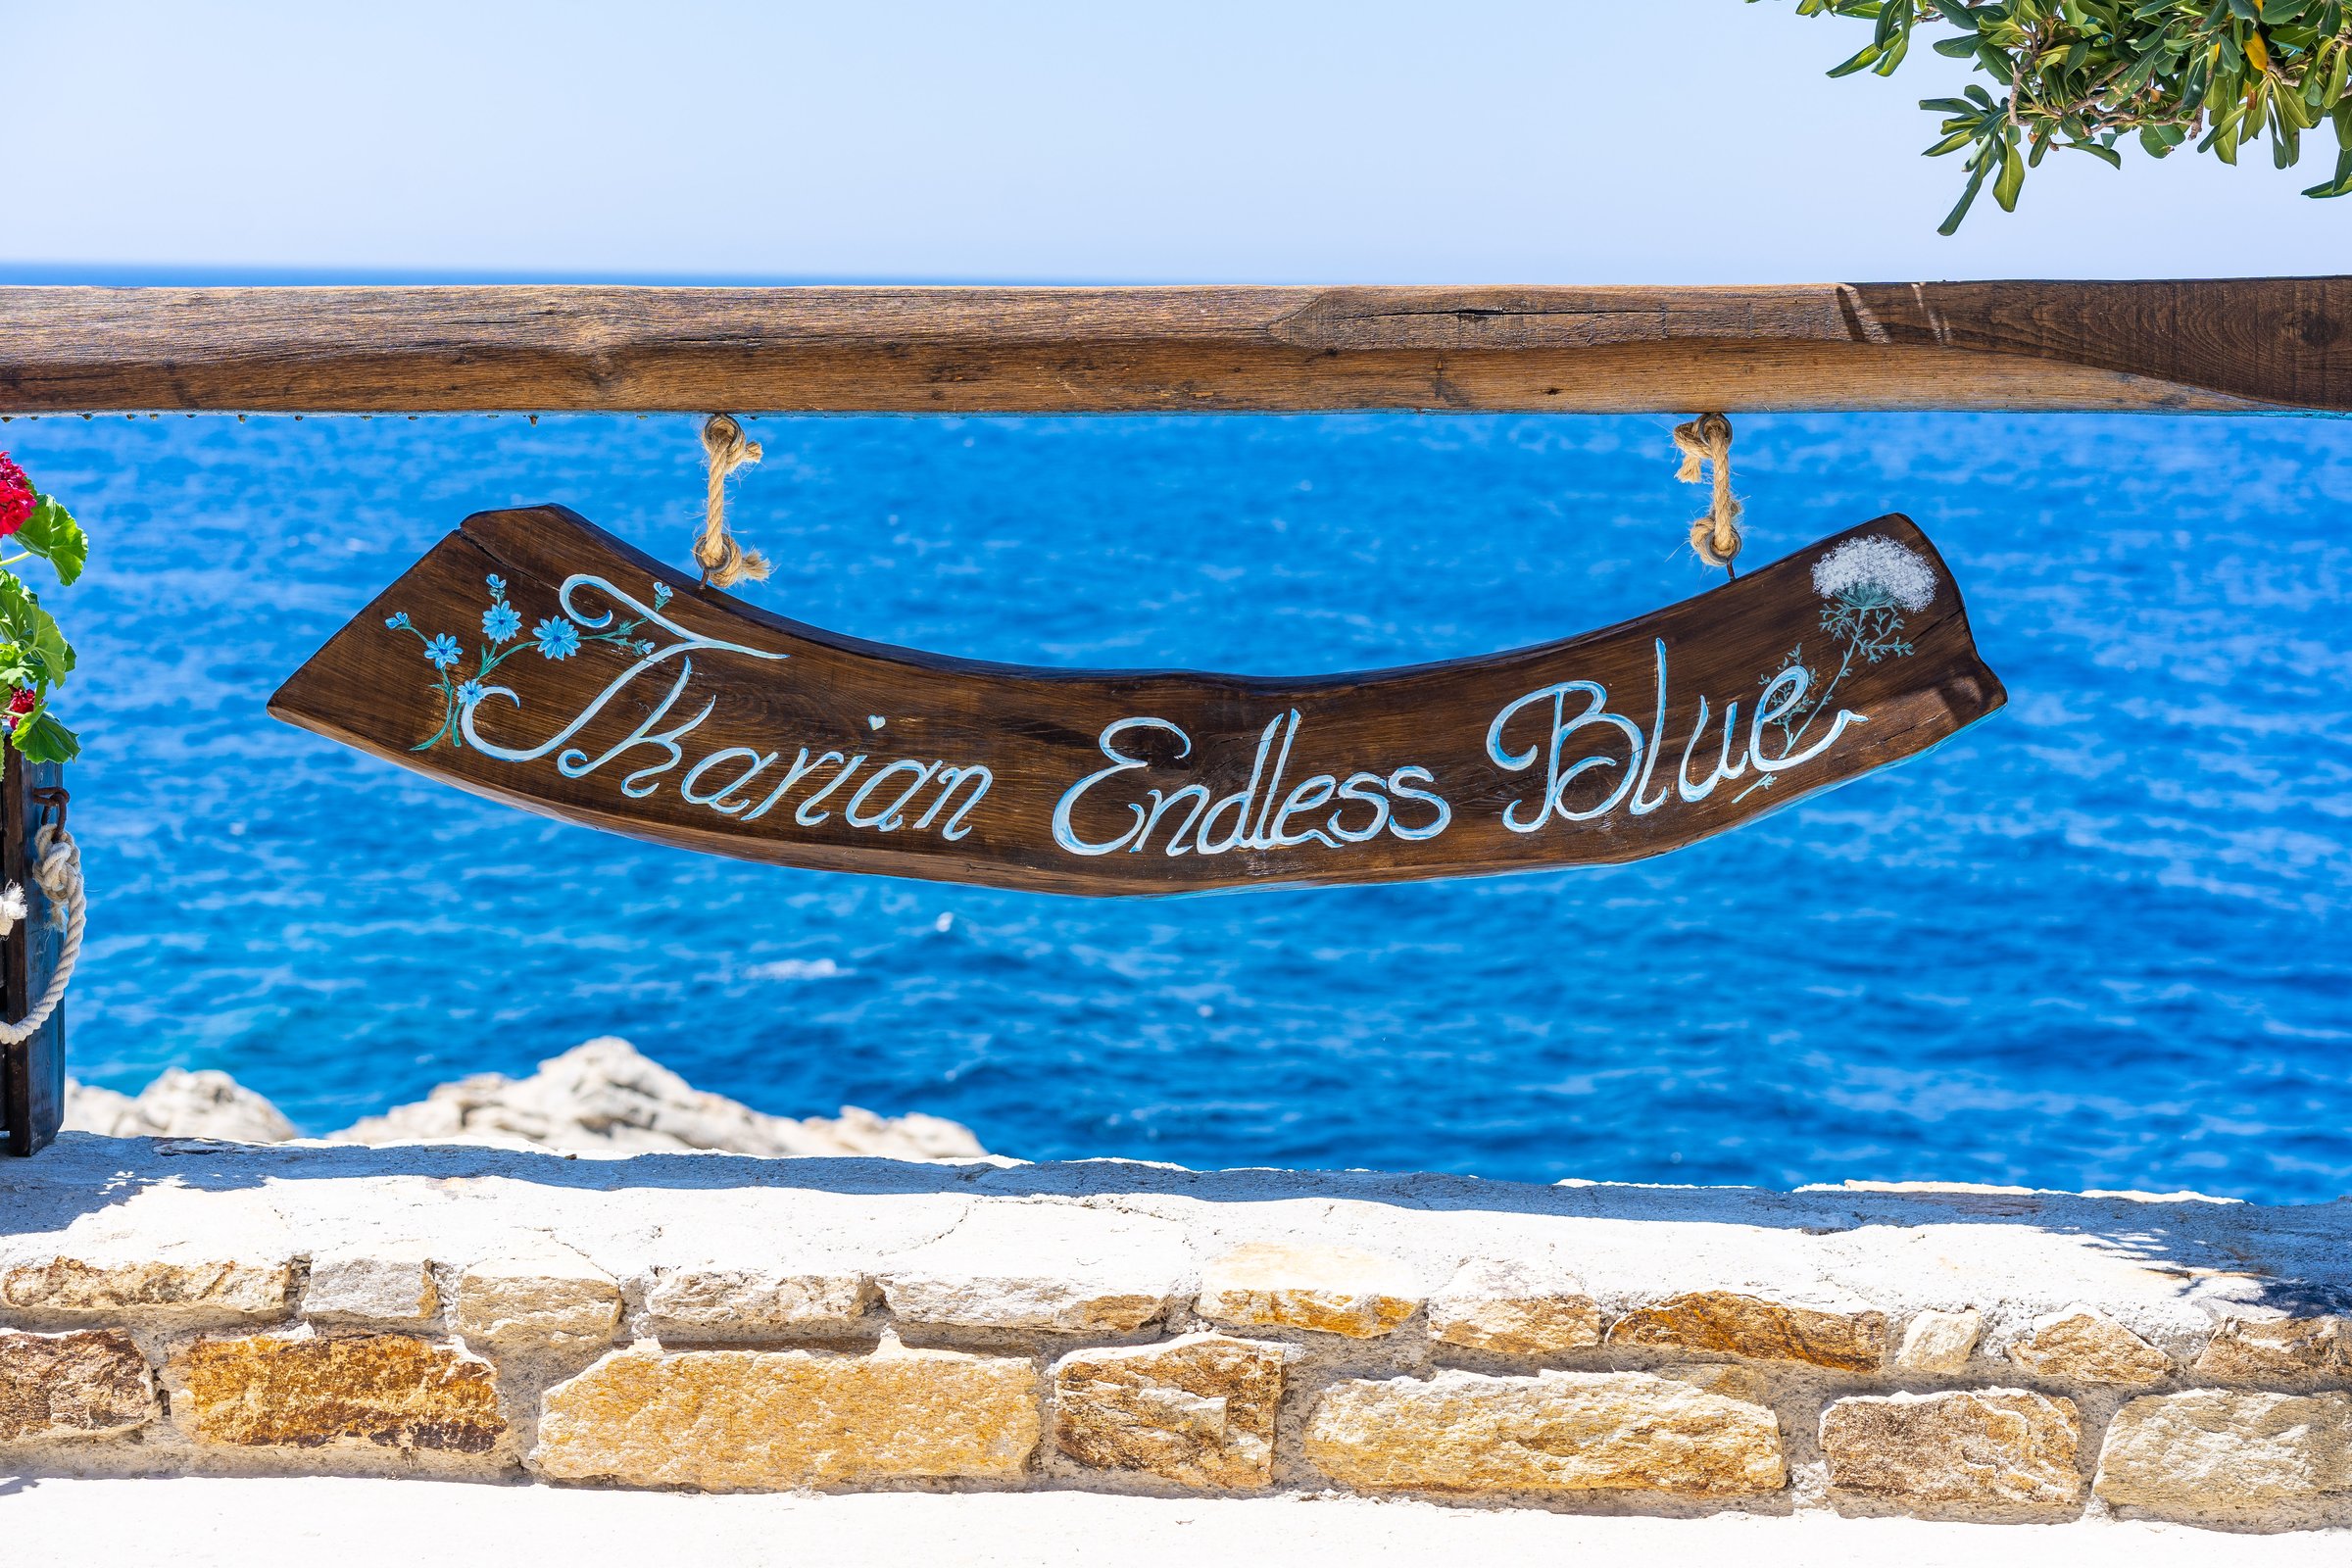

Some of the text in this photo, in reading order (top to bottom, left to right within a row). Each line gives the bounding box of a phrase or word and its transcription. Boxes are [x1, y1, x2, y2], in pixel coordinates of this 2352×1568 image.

[461, 574, 1869, 857] Ikarian Endless Blue
